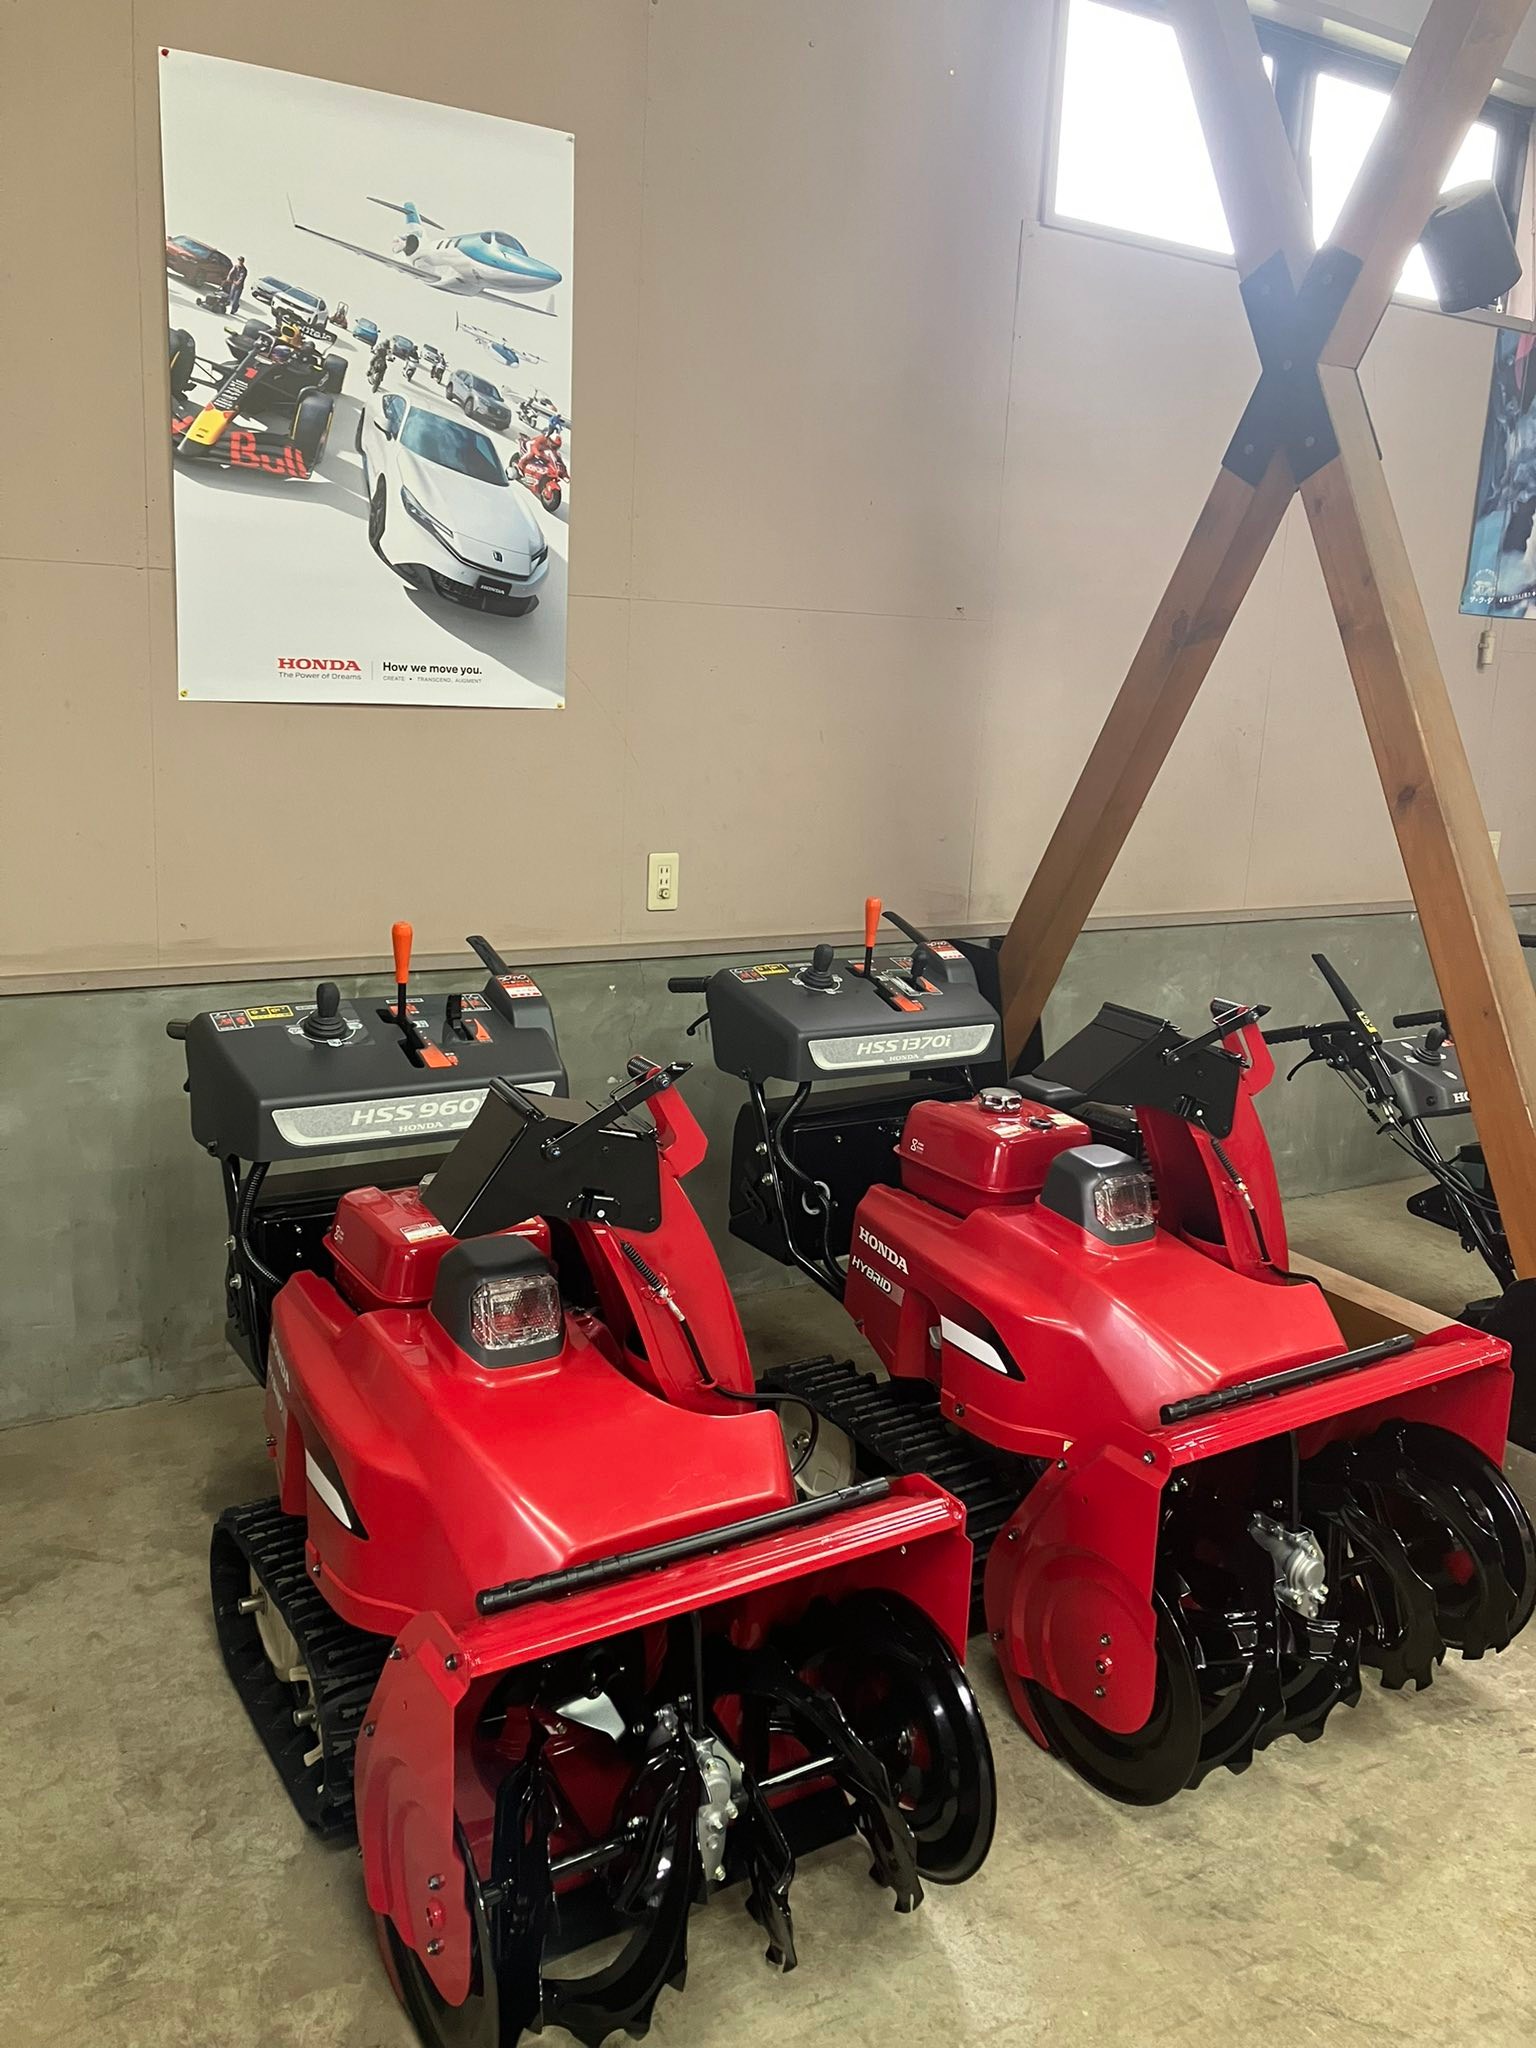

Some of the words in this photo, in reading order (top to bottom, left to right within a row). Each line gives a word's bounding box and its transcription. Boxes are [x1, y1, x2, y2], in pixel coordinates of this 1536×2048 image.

[230, 430, 310, 479] Bull
[277, 657, 362, 671] HONDA
[382, 661, 408, 672] How
[410, 664, 427, 673] we
[429, 665, 459, 674] move
[460, 666, 482, 677] you.
[279, 671, 294, 679] The
[295, 671, 320, 679] Power
[331, 673, 362, 681] Dreams
[382, 674, 405, 682] CREATE
[857, 1039, 900, 1056] HSS
[901, 1034, 952, 1050] 1370i
[889, 1054, 919, 1062] HONDA
[351, 1104, 416, 1126] HSS
[419, 1094, 488, 1118] 960
[399, 1122, 444, 1133] HONDA
[859, 1225, 909, 1275] HONDA
[851, 1255, 892, 1294] HYBRID
